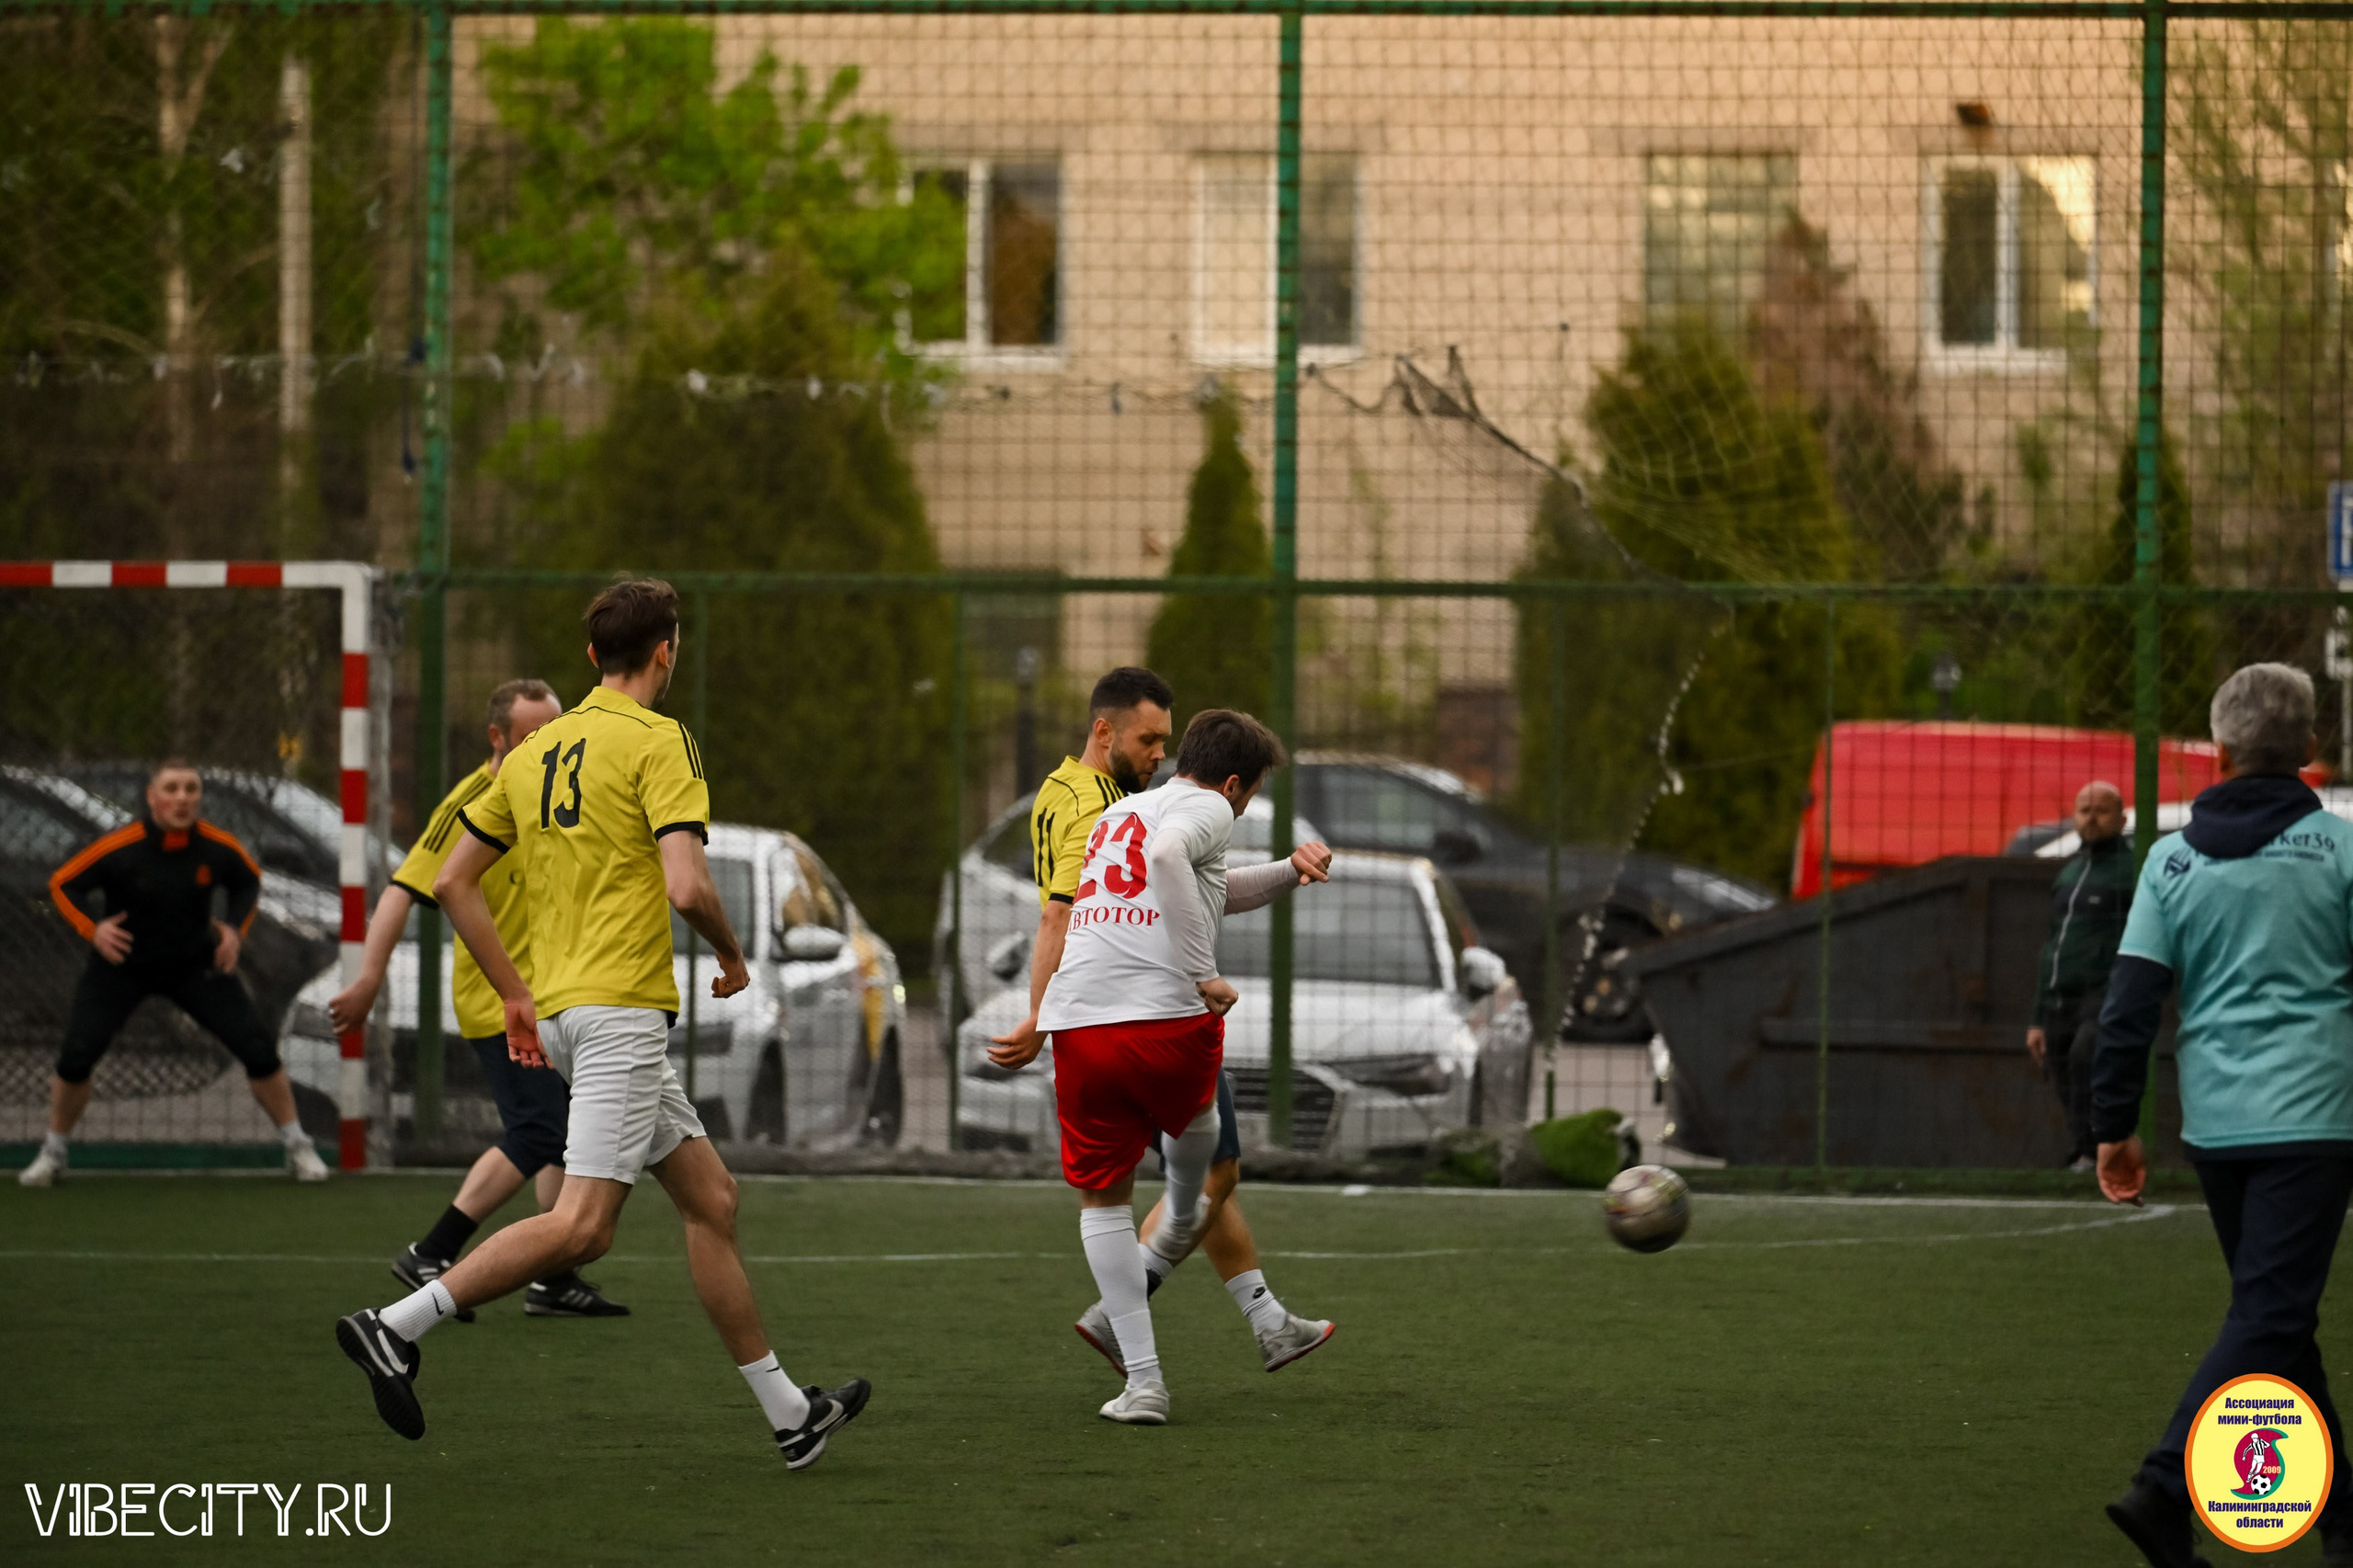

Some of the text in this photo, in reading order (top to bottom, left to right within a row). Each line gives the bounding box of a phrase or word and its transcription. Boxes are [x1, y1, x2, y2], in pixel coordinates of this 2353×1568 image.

[541, 738, 586, 829] 13
[1037, 807, 1055, 887] 11
[1073, 812, 1147, 903] 23
[1069, 906, 1160, 932] ВТОТОР
